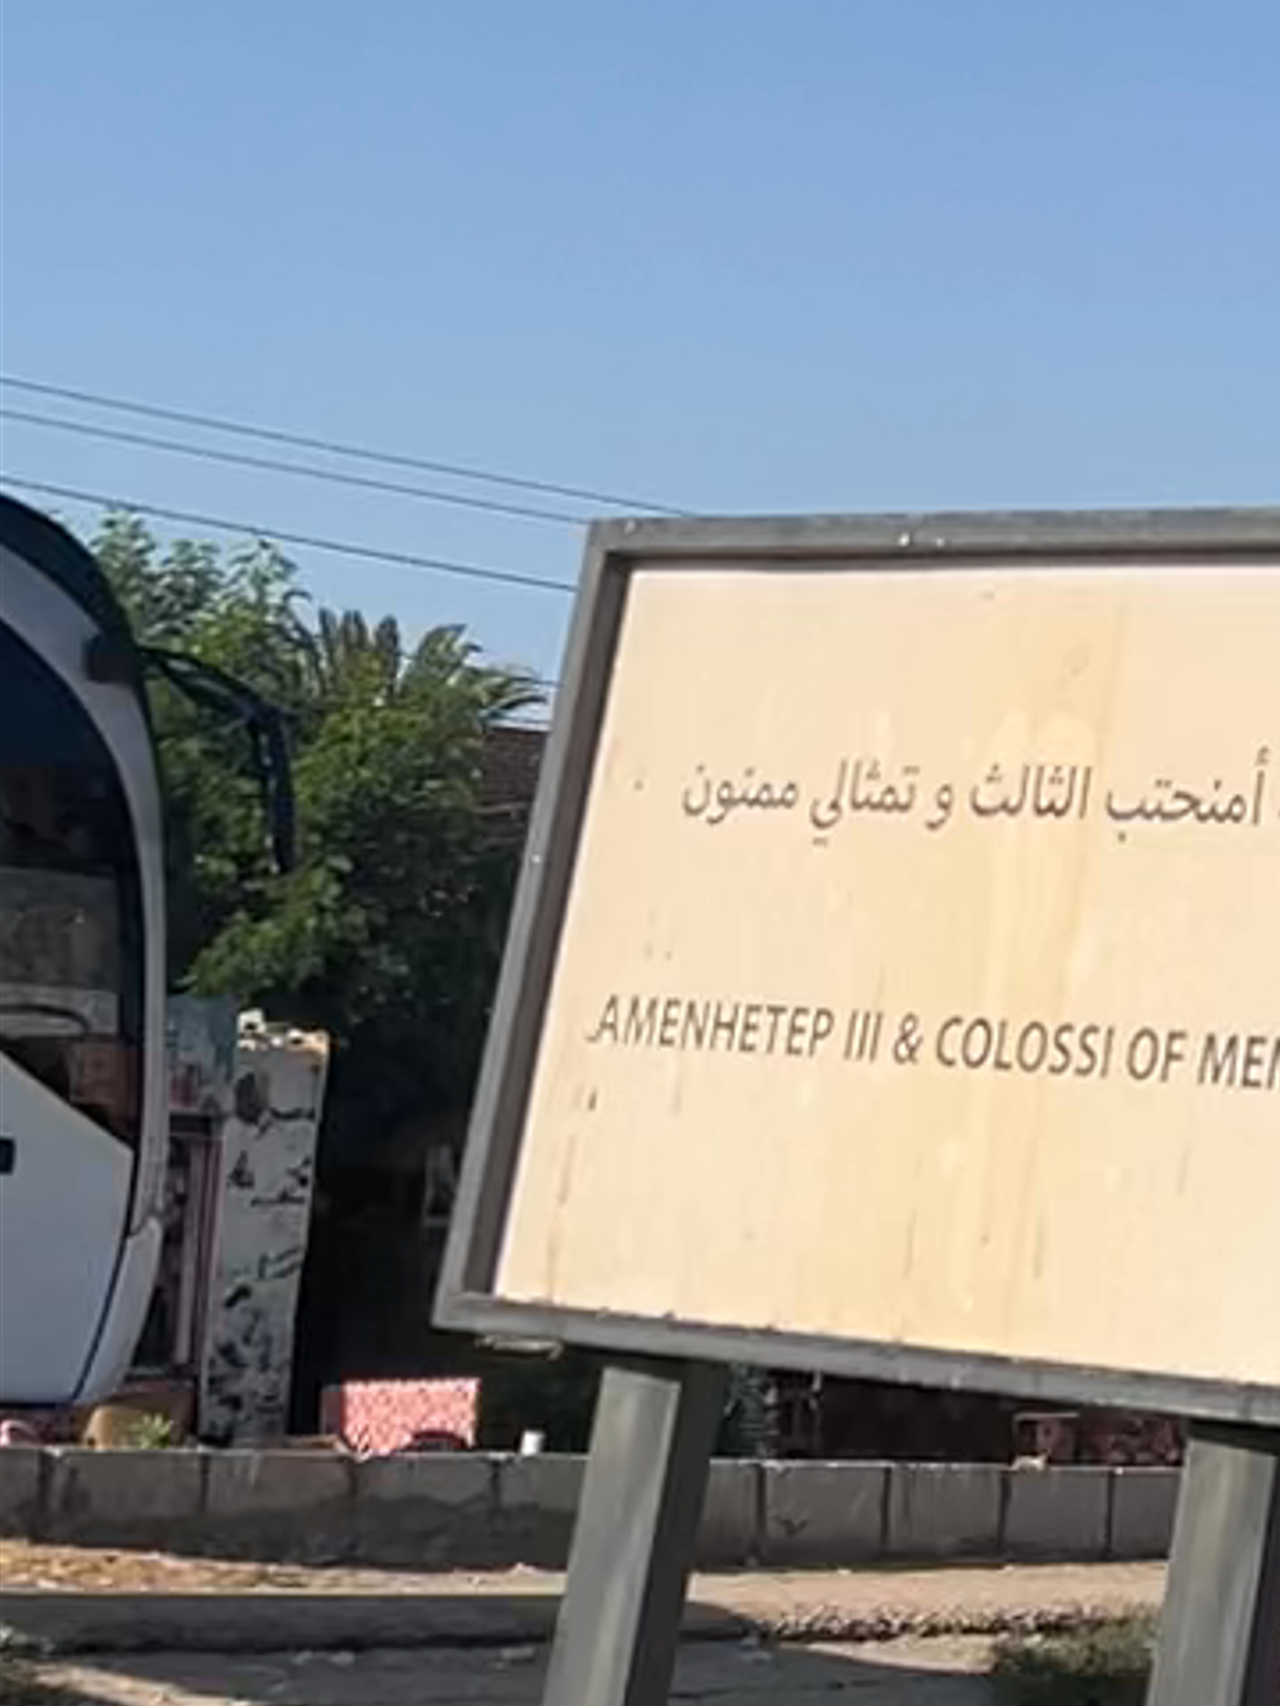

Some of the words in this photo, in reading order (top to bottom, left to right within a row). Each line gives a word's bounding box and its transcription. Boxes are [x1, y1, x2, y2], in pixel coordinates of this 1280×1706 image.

[681, 762, 799, 826] ممنون
[925, 782, 954, 832] و
[970, 762, 1094, 822] الثالث
[1105, 744, 1271, 843] أمنحتب
[598, 993, 836, 1058] AMENHETEP
[842, 1009, 884, 1063] III
[892, 1011, 923, 1064] &
[934, 1014, 1115, 1079] COLOSSI
[1126, 1027, 1189, 1083] OF
